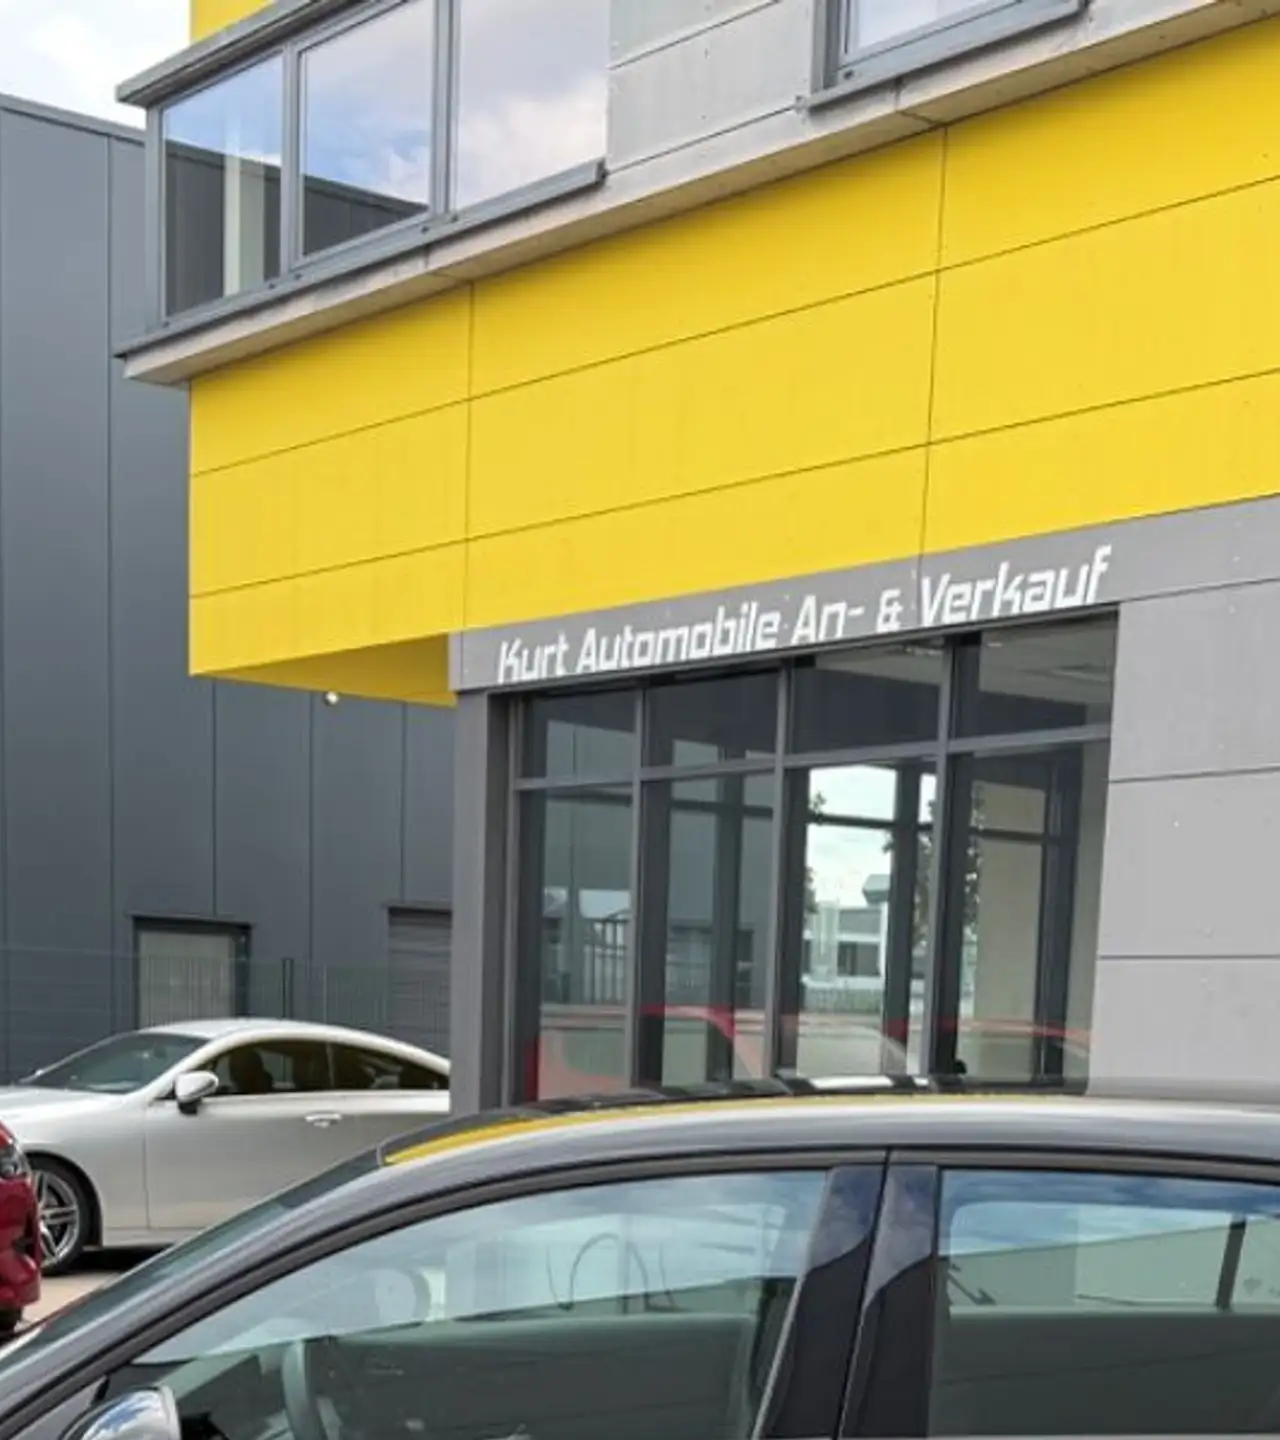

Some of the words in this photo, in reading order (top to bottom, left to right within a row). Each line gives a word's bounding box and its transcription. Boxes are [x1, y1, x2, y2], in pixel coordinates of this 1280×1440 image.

[497, 632, 569, 684] Kurt
[575, 602, 780, 674] Automobile
[789, 594, 865, 646] An-
[876, 587, 904, 633] &
[920, 544, 1112, 628] Verkauf
